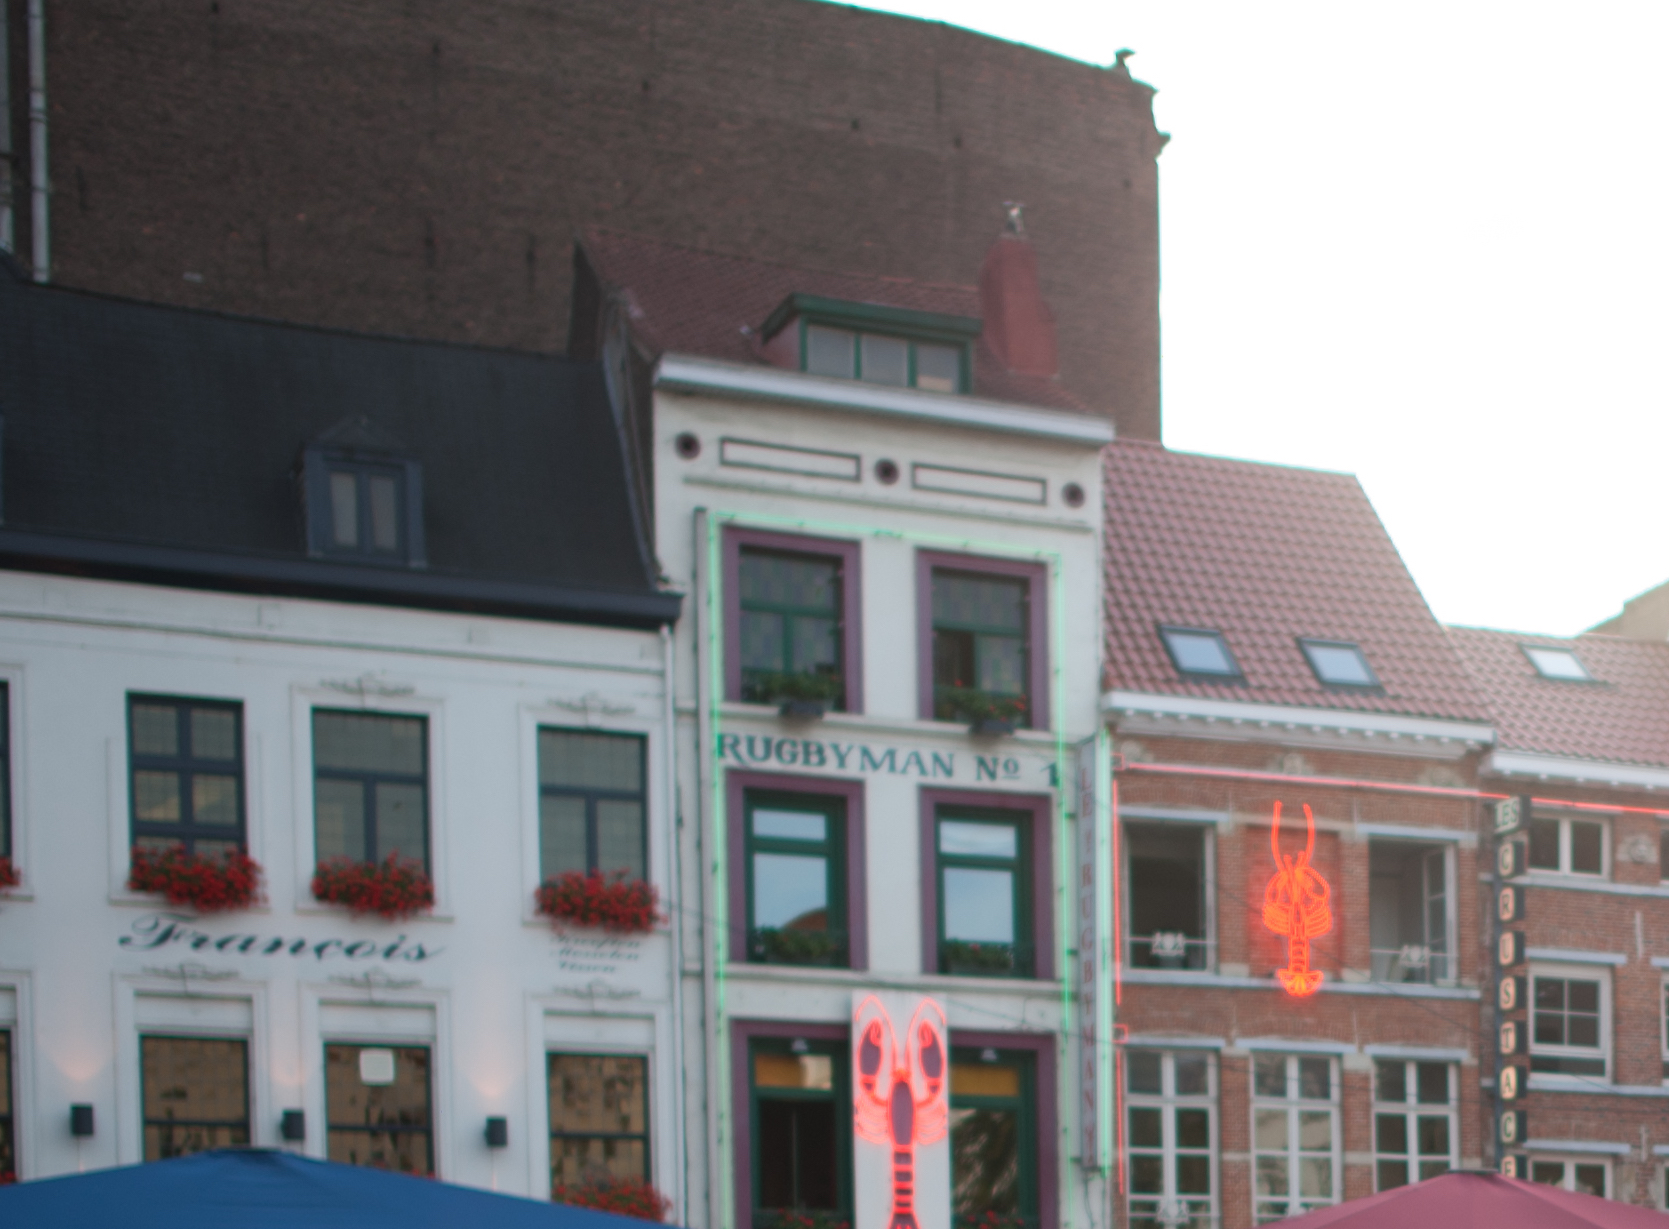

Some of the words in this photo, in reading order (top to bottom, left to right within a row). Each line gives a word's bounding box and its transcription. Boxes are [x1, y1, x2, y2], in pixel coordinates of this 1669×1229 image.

[717, 733, 955, 778] RUGBYMAN
[1495, 801, 1520, 829] LES
[118, 913, 447, 962] François
